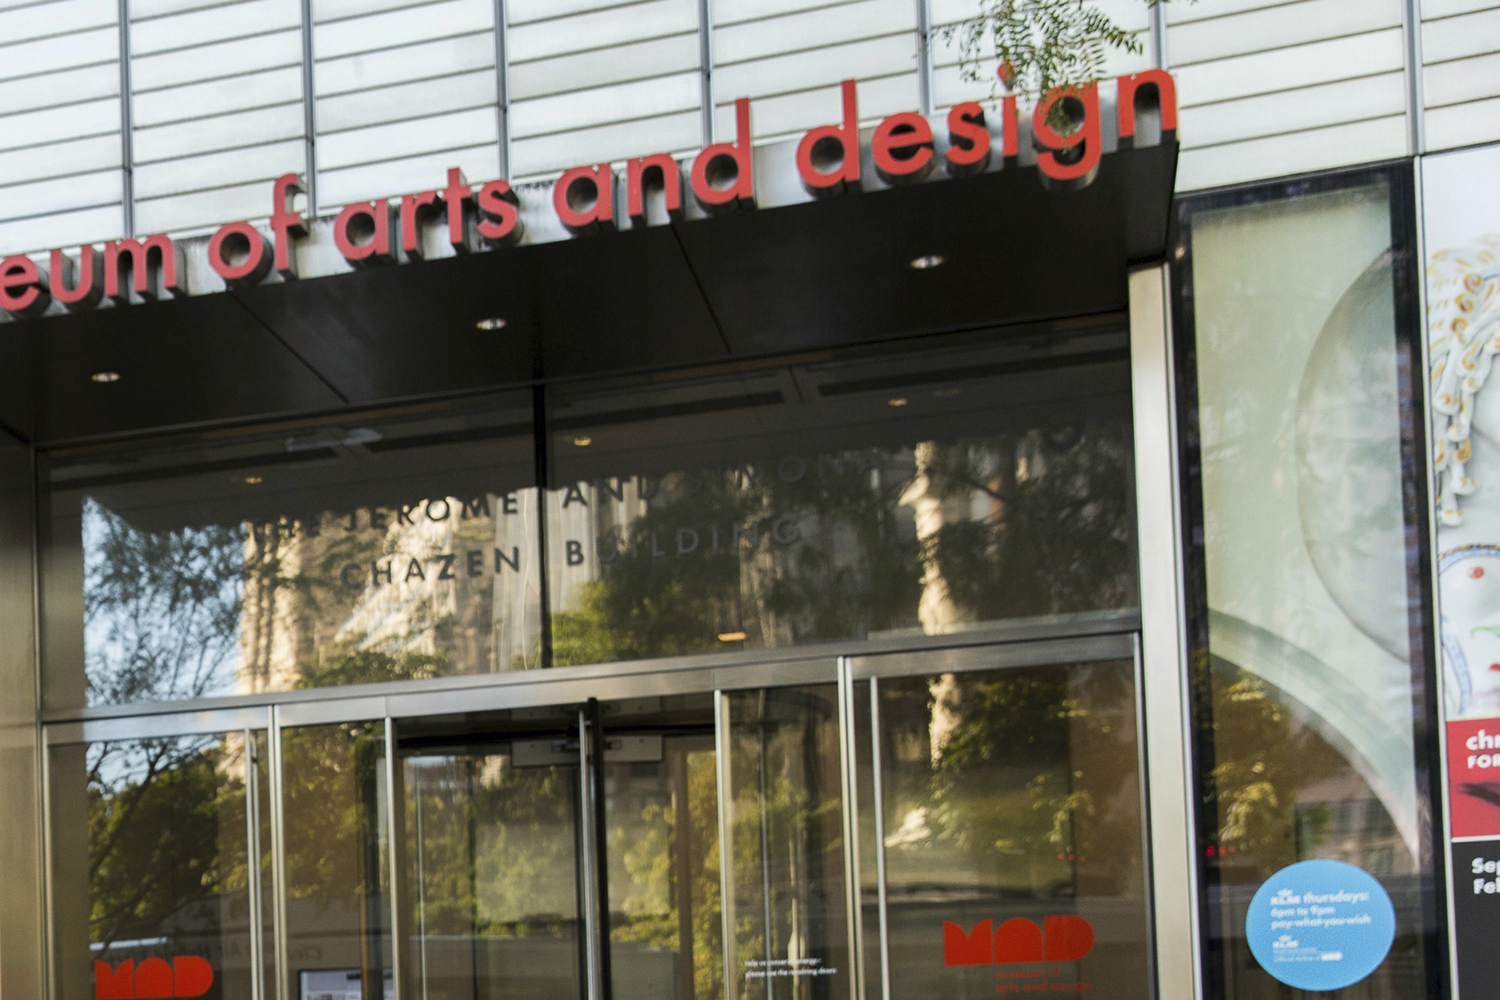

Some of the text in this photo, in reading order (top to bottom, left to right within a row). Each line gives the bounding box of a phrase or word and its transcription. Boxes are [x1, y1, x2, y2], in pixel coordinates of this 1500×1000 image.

[207, 172, 306, 280] of
[333, 166, 518, 260] arts
[552, 97, 754, 226] and
[796, 61, 1177, 188] design
[340, 516, 801, 589] CHAZEN BUILDING
[1297, 907, 1309, 916] to
[1023, 981, 1047, 992] and
